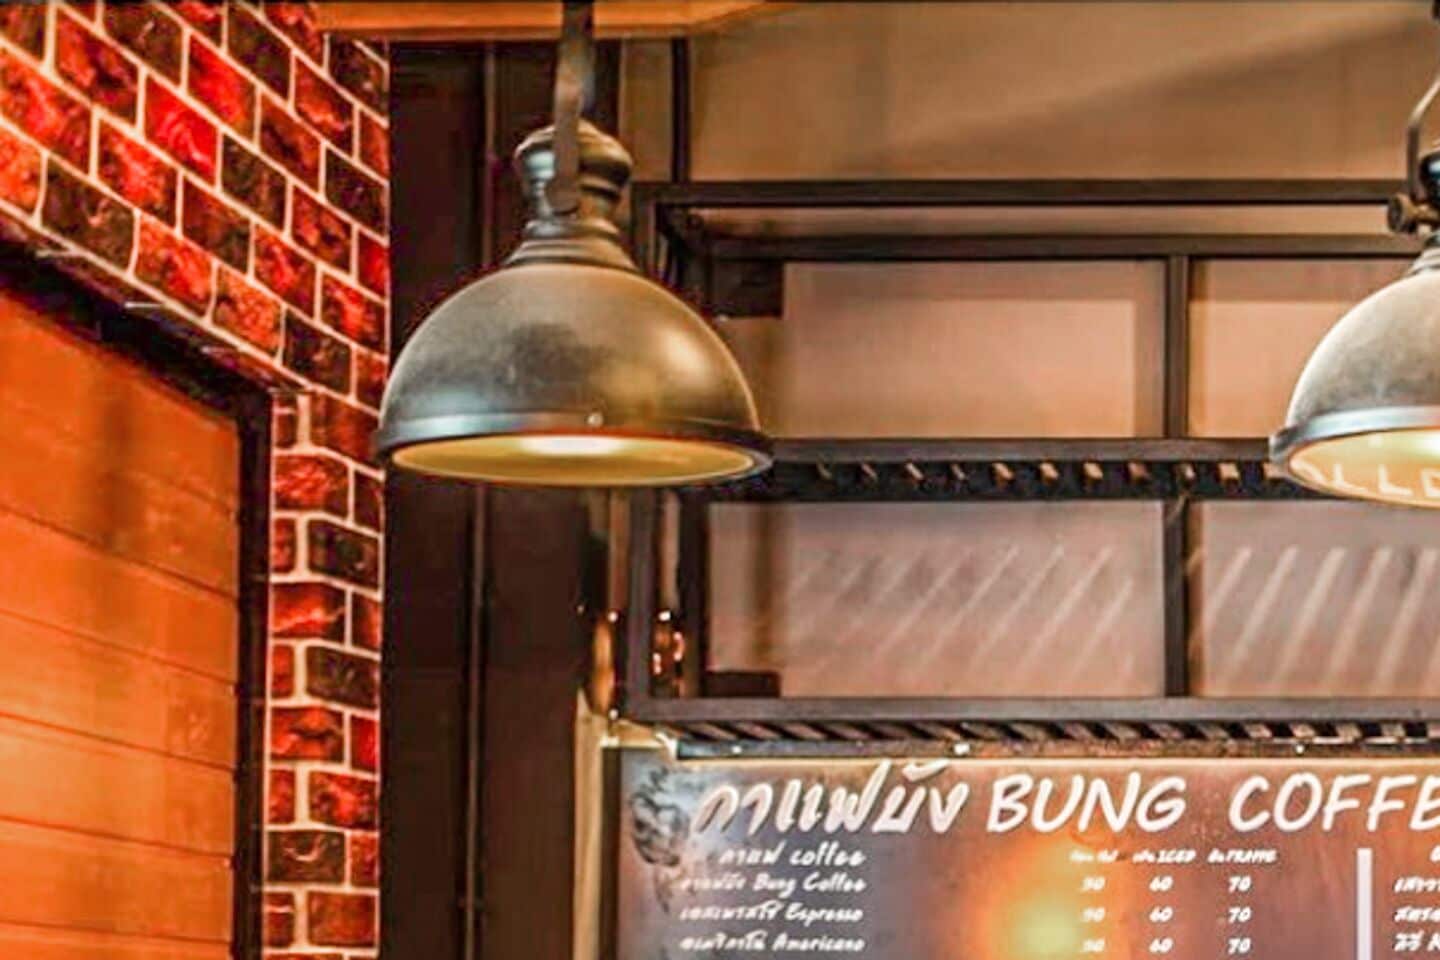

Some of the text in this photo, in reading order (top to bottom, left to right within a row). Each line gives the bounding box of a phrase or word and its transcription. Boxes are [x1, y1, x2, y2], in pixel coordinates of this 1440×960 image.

[986, 772, 1187, 833] BUNG
[790, 841, 865, 866] coffee
[753, 873, 796, 898] Bung
[1229, 876, 1251, 893] 70
[785, 902, 863, 927] Espresso
[1229, 907, 1251, 923] 70
[772, 932, 864, 951] Americano
[1228, 938, 1251, 954] 70
